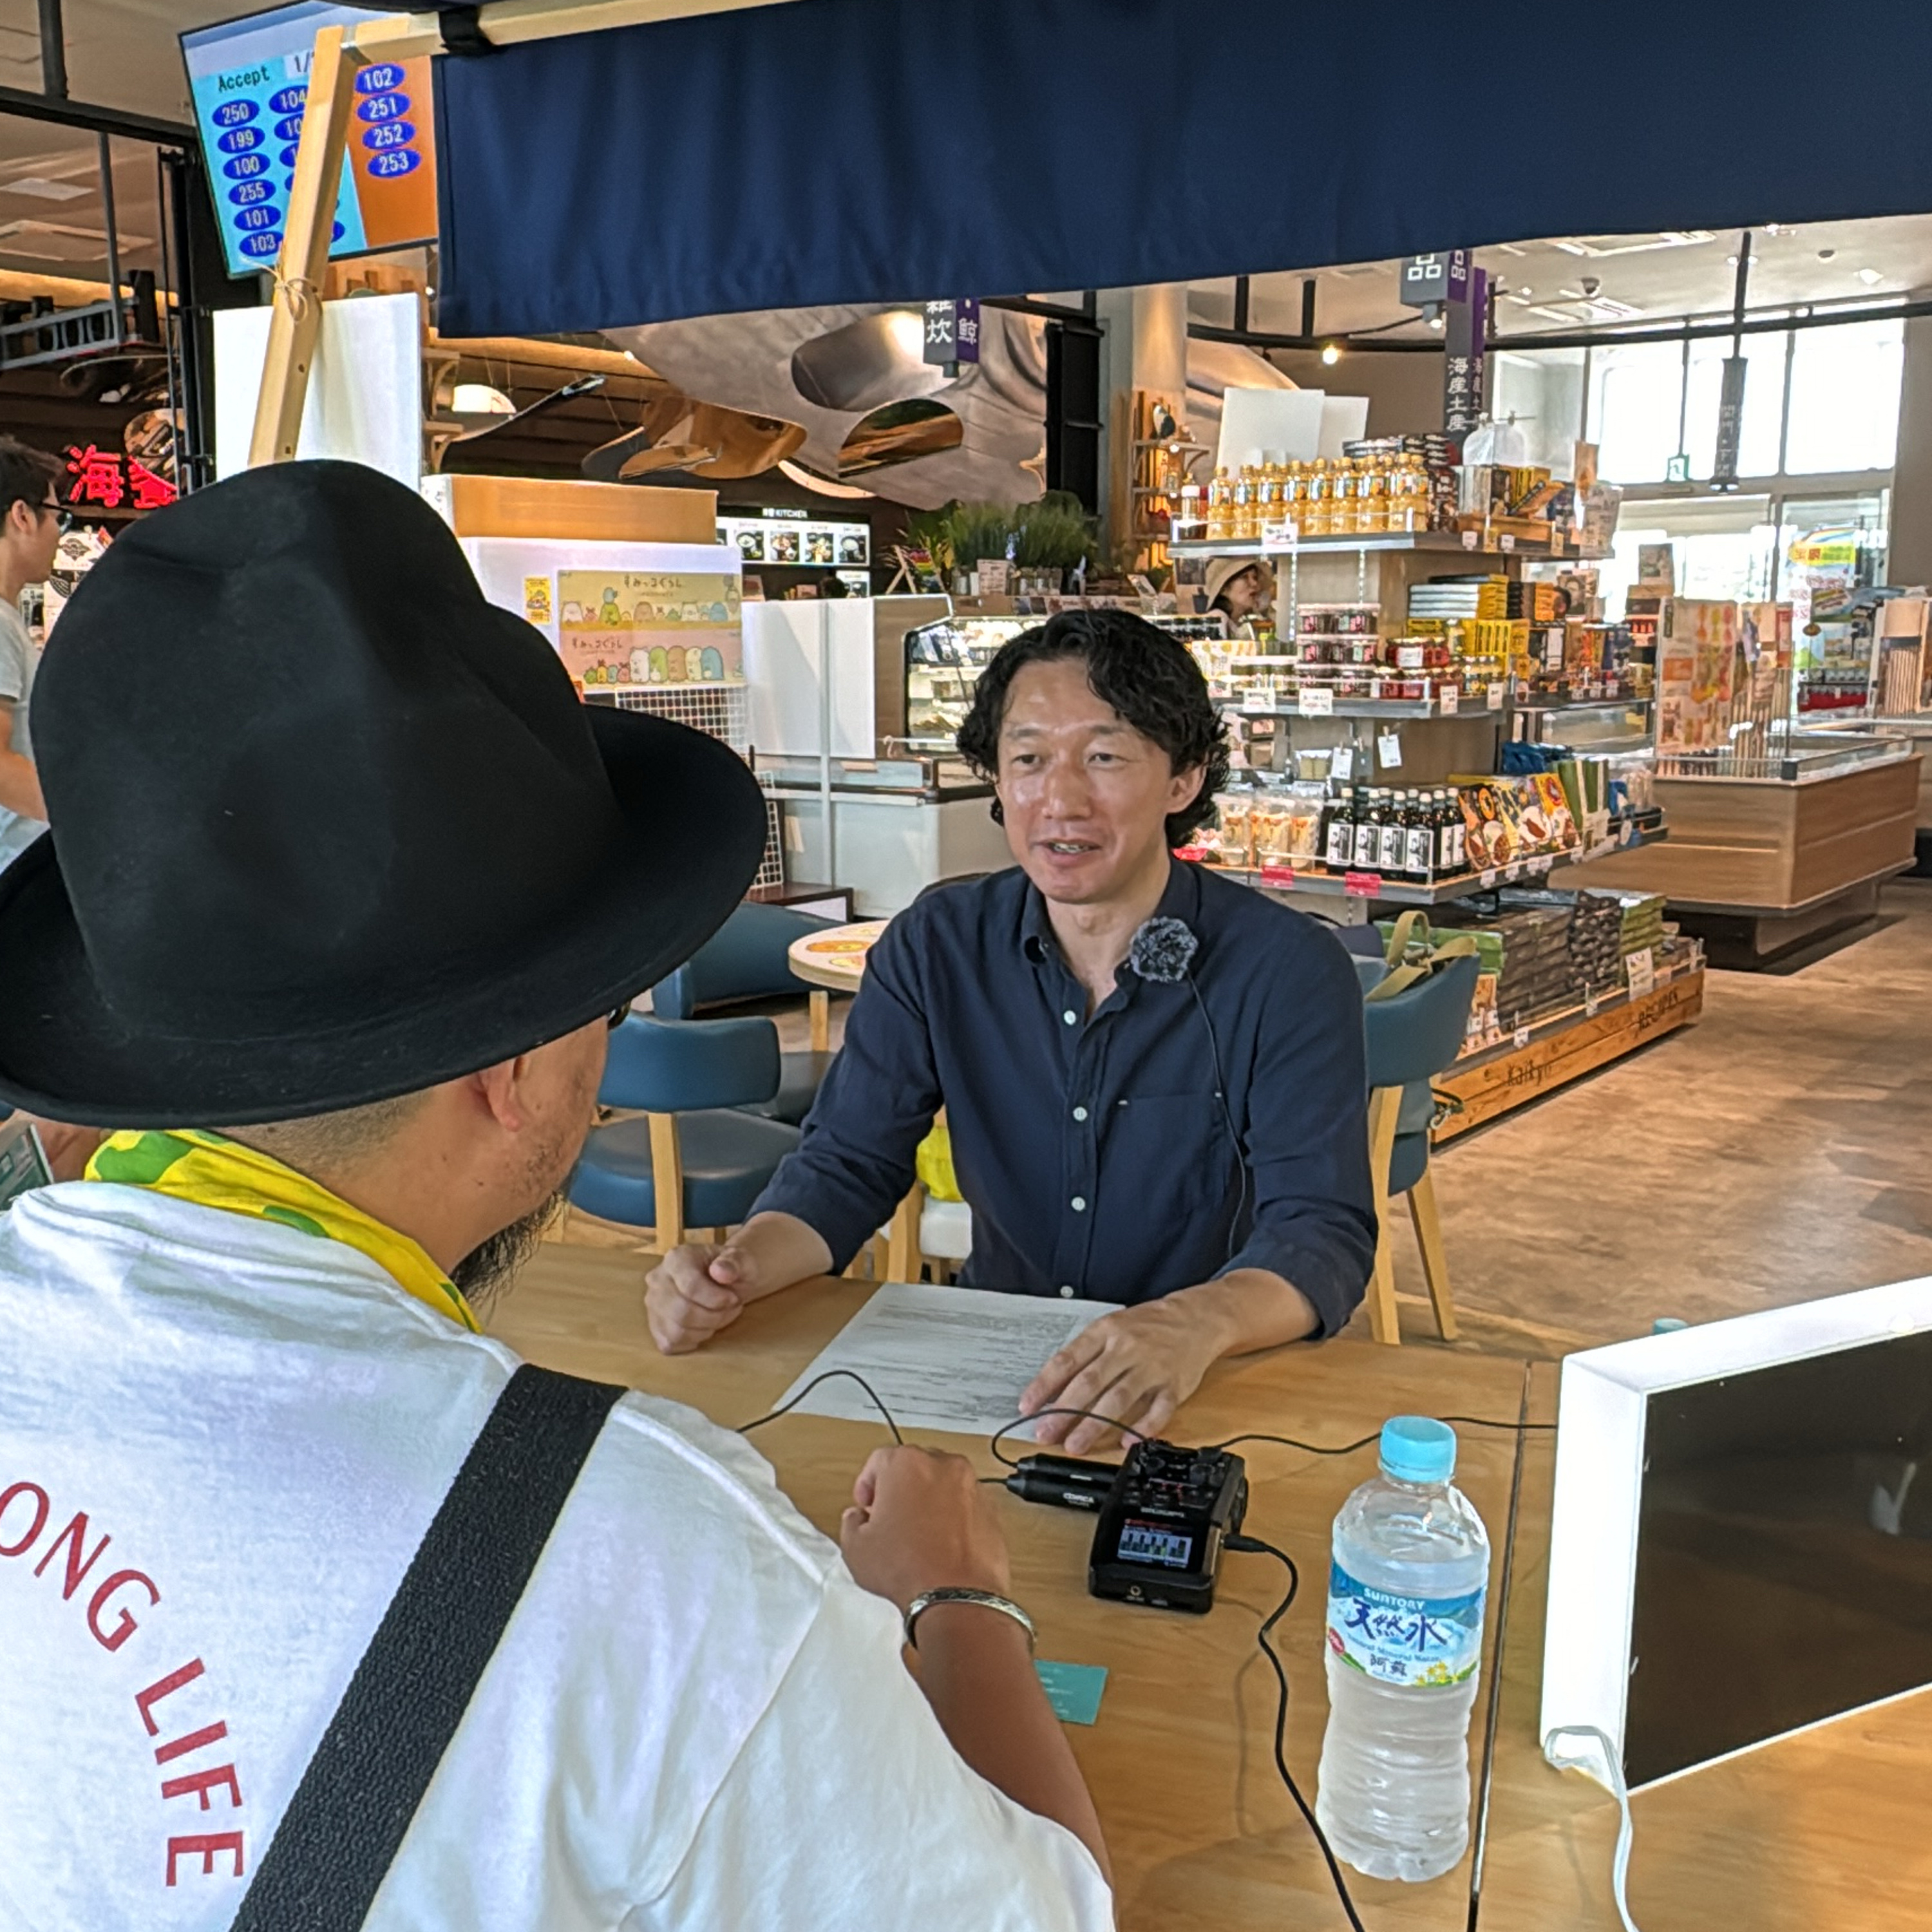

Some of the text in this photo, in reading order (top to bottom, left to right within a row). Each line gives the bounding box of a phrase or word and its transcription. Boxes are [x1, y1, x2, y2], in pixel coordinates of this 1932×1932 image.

[218, 66, 270, 92] Accept
[363, 68, 393, 91] 102
[222, 102, 249, 125] 250
[368, 96, 396, 119] 251
[228, 131, 254, 152] 199
[374, 124, 404, 147] 252
[233, 157, 260, 178] 100
[379, 152, 410, 175] 253
[239, 183, 265, 204] 255
[245, 208, 270, 229] 101
[250, 234, 276, 255] 103
[1446, 357, 1469, 431] 海産土産
[1344, 1597, 1448, 1652] 天然水
[135, 1656, 243, 1886] LIFE
